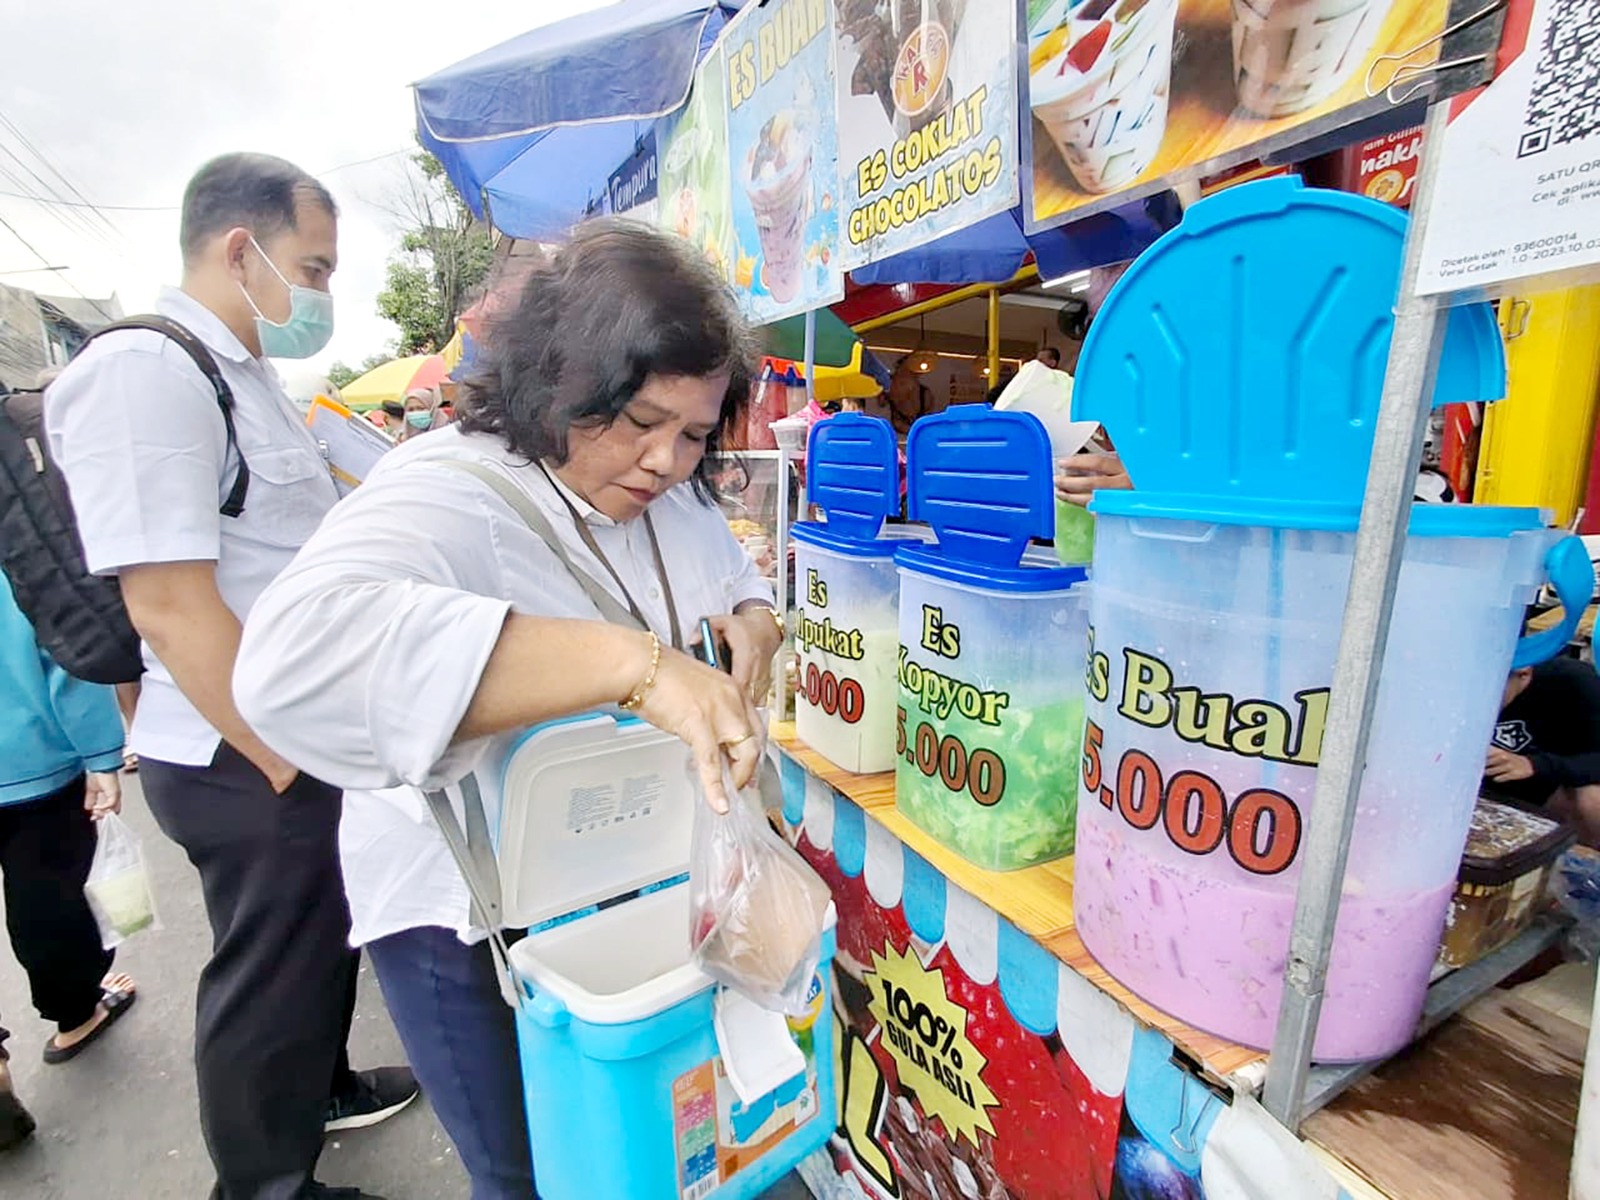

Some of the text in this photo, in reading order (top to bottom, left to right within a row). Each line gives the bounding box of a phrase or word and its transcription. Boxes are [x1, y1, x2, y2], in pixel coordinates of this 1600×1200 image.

[729, 39, 757, 111] ES
[858, 84, 987, 198] ES COKLAT
[611, 154, 657, 217] Tempura
[848, 135, 1002, 245] CHOCOLATOS
[1532, 190, 1557, 203] Cek
[1537, 166, 1575, 185] SATU
[1439, 265, 1465, 278] Versi
[1467, 260, 1498, 273] Cetak
[1441, 255, 1479, 268] Dicetak
[1513, 232, 1577, 254] 93600014
[808, 568, 827, 608] Es
[796, 608, 864, 660] lpukat
[921, 604, 960, 659] Es
[1082, 717, 1302, 876] 5.000
[881, 978, 963, 1070] 100%
[886, 1019, 976, 1111] GULA ASLI
